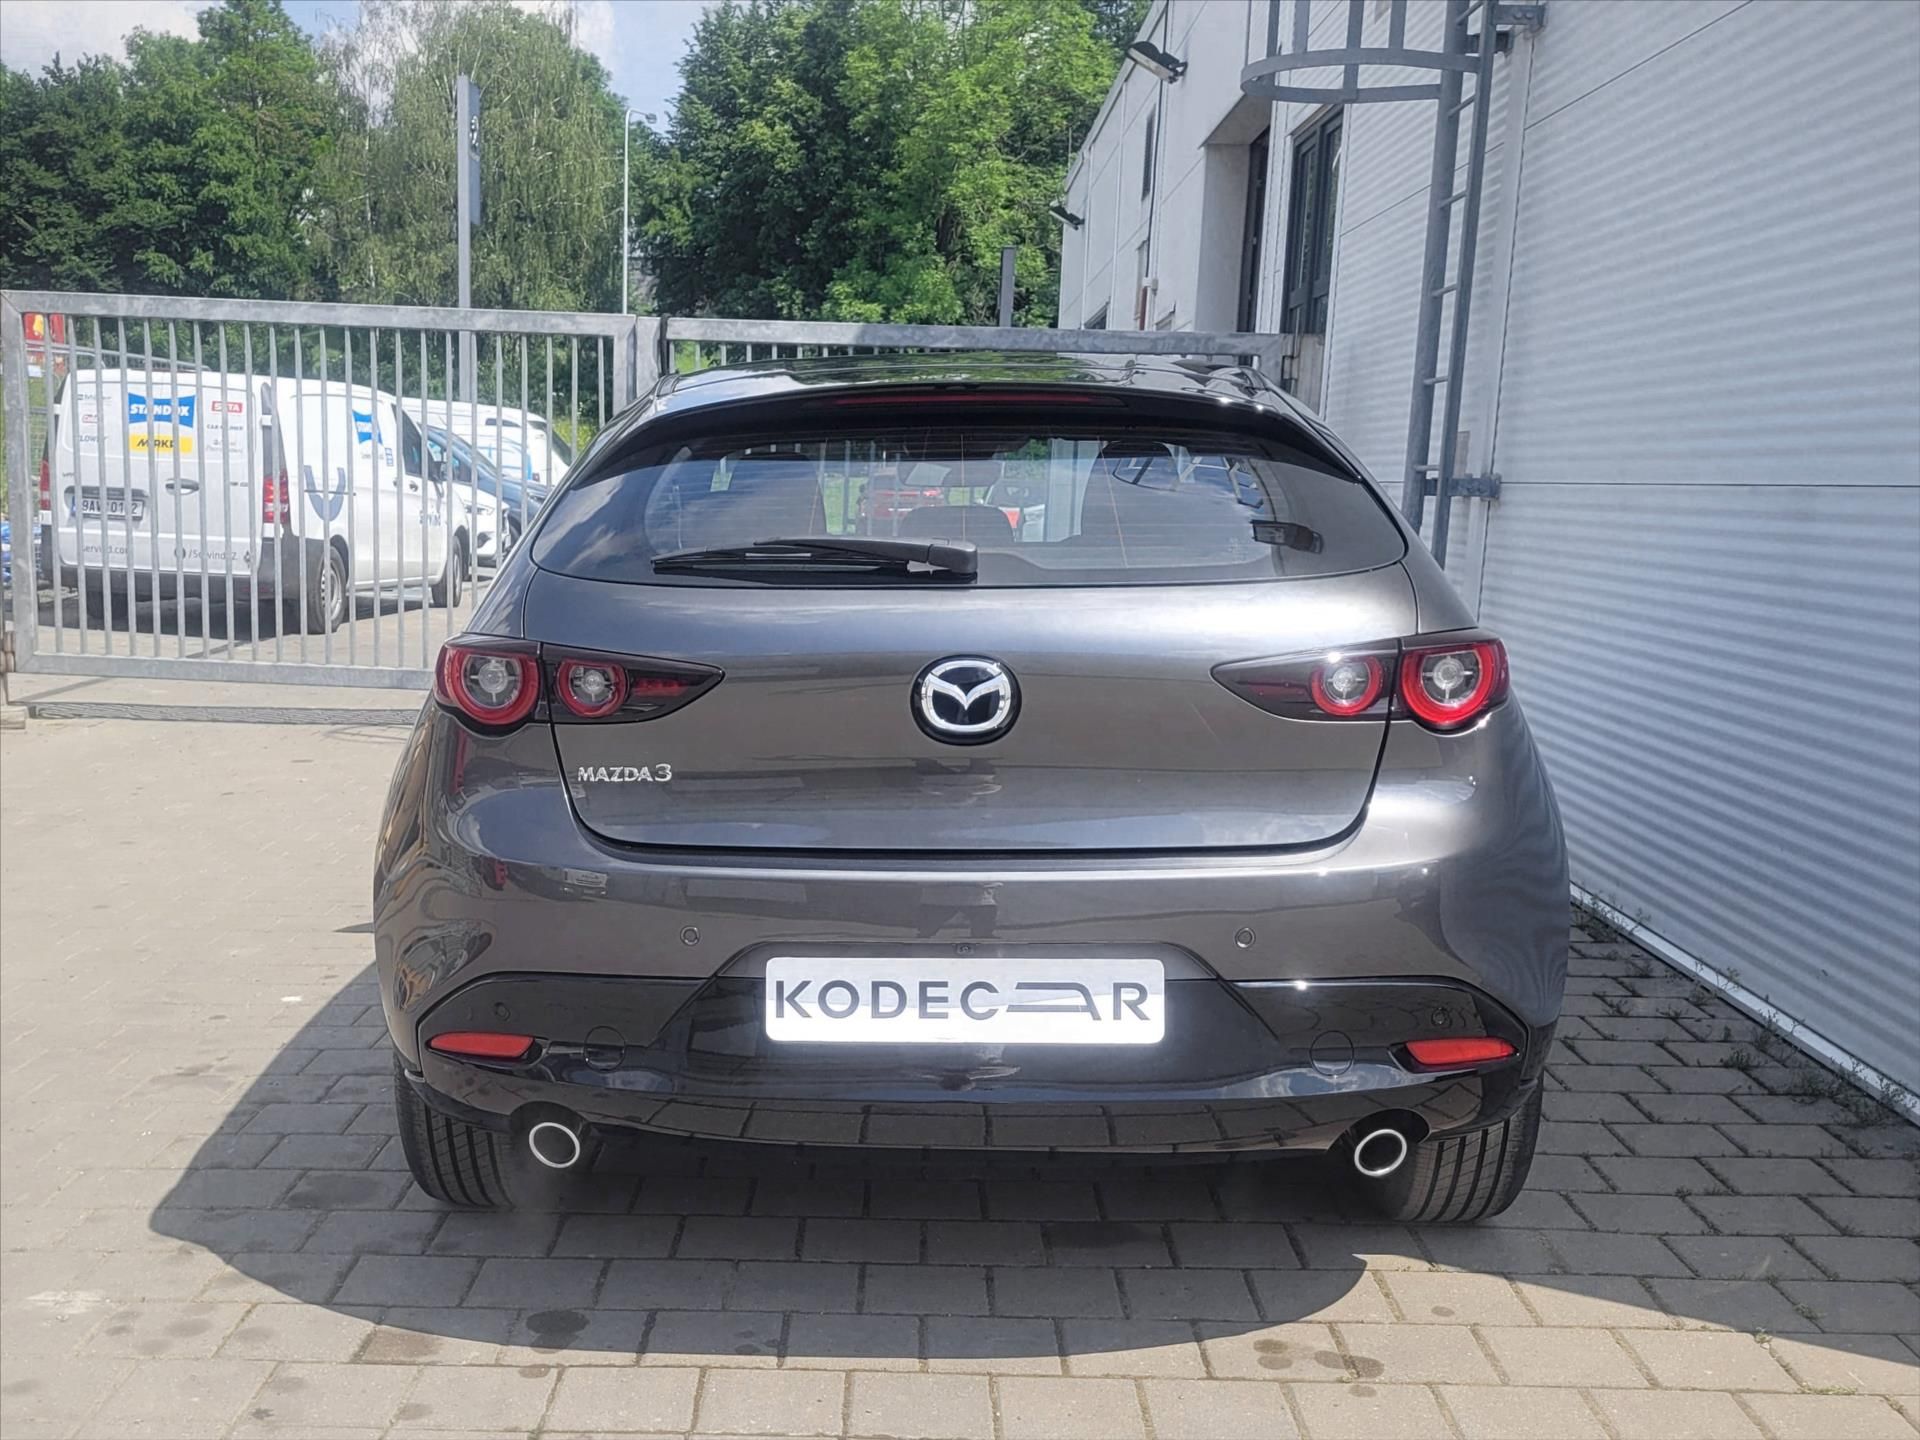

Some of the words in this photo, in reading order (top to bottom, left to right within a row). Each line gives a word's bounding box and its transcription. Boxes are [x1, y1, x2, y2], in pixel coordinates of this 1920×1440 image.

[130, 404, 190, 416] STNDX
[214, 403, 240, 411] STA
[111, 502, 138, 515] 012
[775, 980, 1150, 1021] KODECAR
